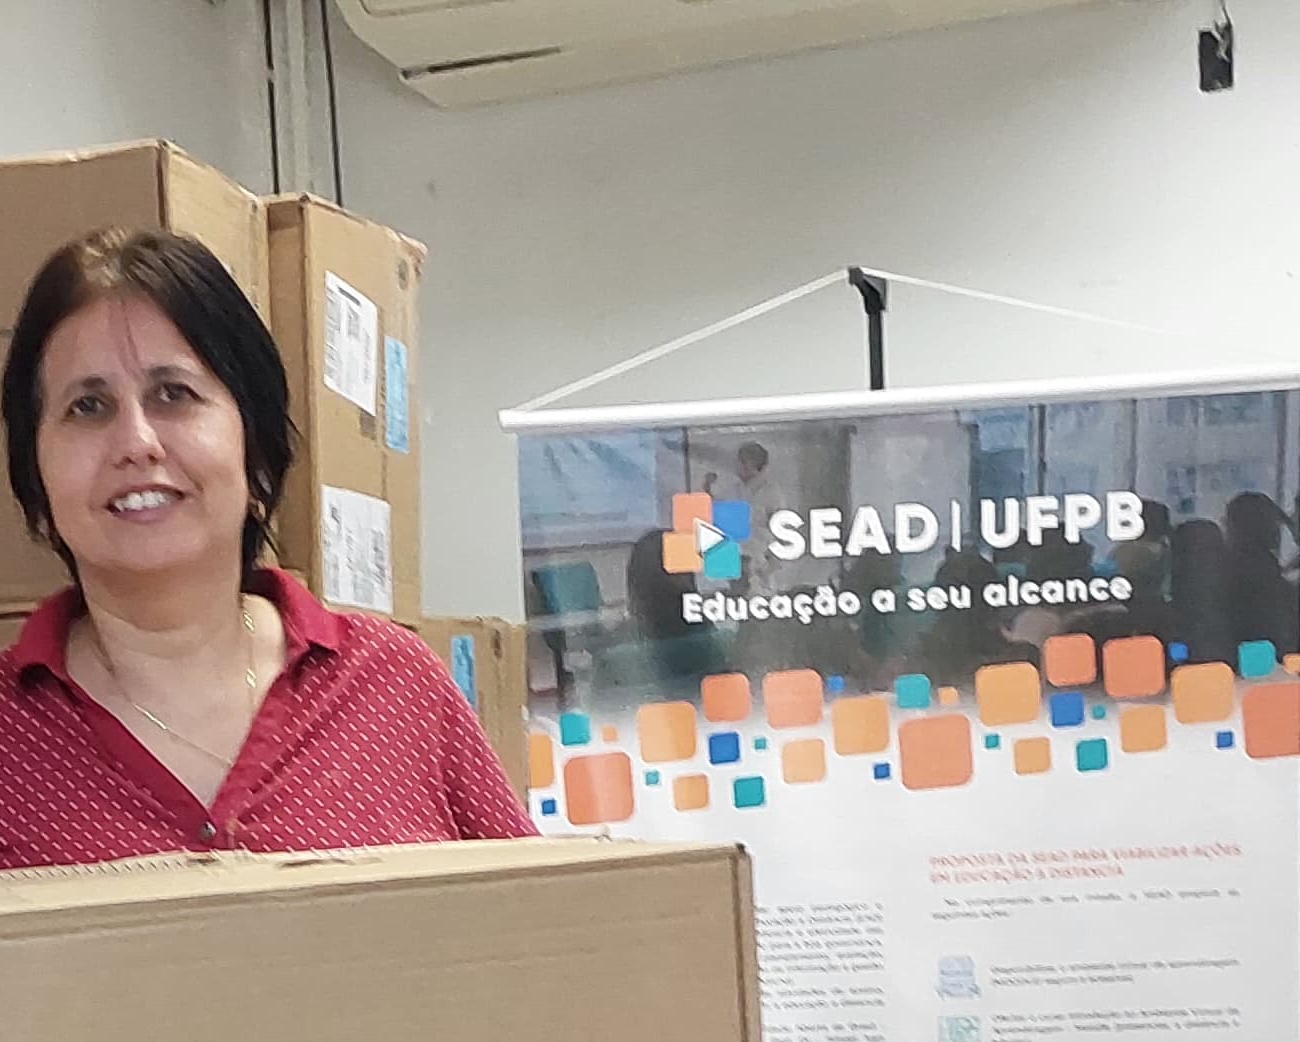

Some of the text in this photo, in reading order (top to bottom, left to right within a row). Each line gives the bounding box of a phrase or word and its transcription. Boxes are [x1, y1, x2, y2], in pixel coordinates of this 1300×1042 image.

[767, 489, 1146, 560] SEAD UFPB
[681, 573, 1134, 625] Educação a seu alcance
